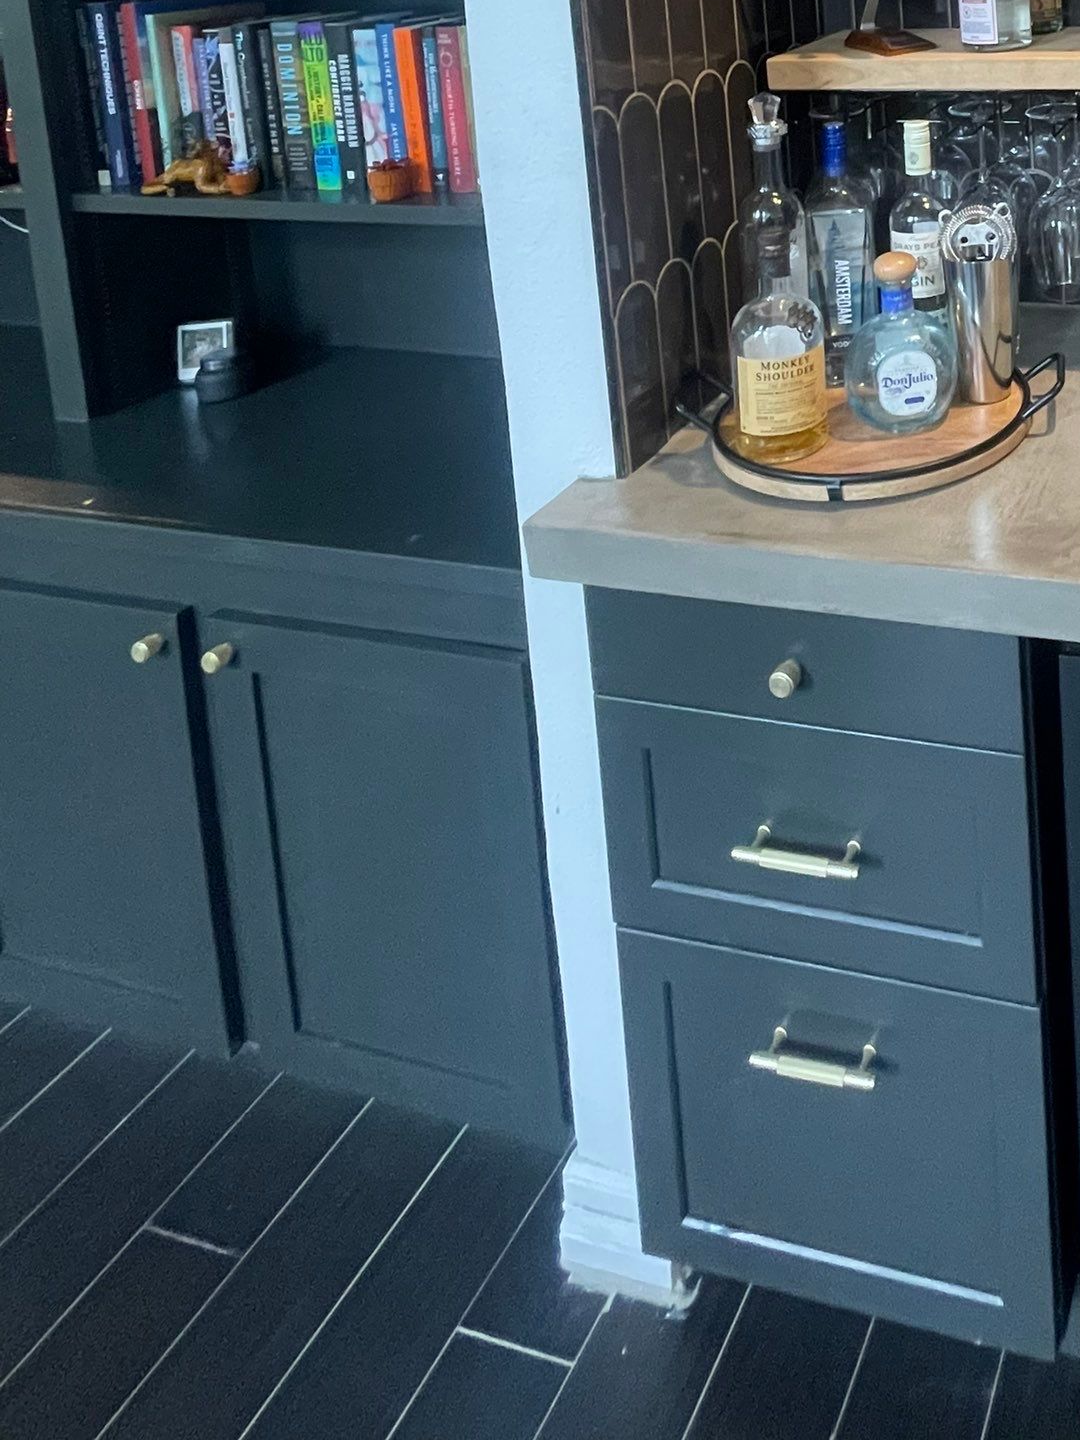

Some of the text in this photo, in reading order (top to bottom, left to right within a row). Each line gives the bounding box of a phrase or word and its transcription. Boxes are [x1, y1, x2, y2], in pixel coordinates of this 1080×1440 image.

[235, 31, 244, 51] The
[381, 33, 390, 59] THINK
[99, 46, 117, 115] TECHNIQUES
[276, 43, 303, 135] DOMINION
[328, 60, 345, 143] CONFIDENCE MAN
[337, 54, 359, 148] MAGGIE HABERMAN
[388, 90, 396, 114] MONK
[268, 113, 280, 154] ETHER
[390, 123, 398, 137] JAY
[449, 112, 457, 146] TURNING
[923, 242, 940, 250] PEA
[834, 260, 853, 325] AMSTERDAM
[911, 275, 935, 287] GIN
[832, 340, 851, 349] VOD
[755, 363, 815, 381] SHOULDER
[760, 354, 810, 371] MONKEY
[881, 371, 934, 389] Don Julio
